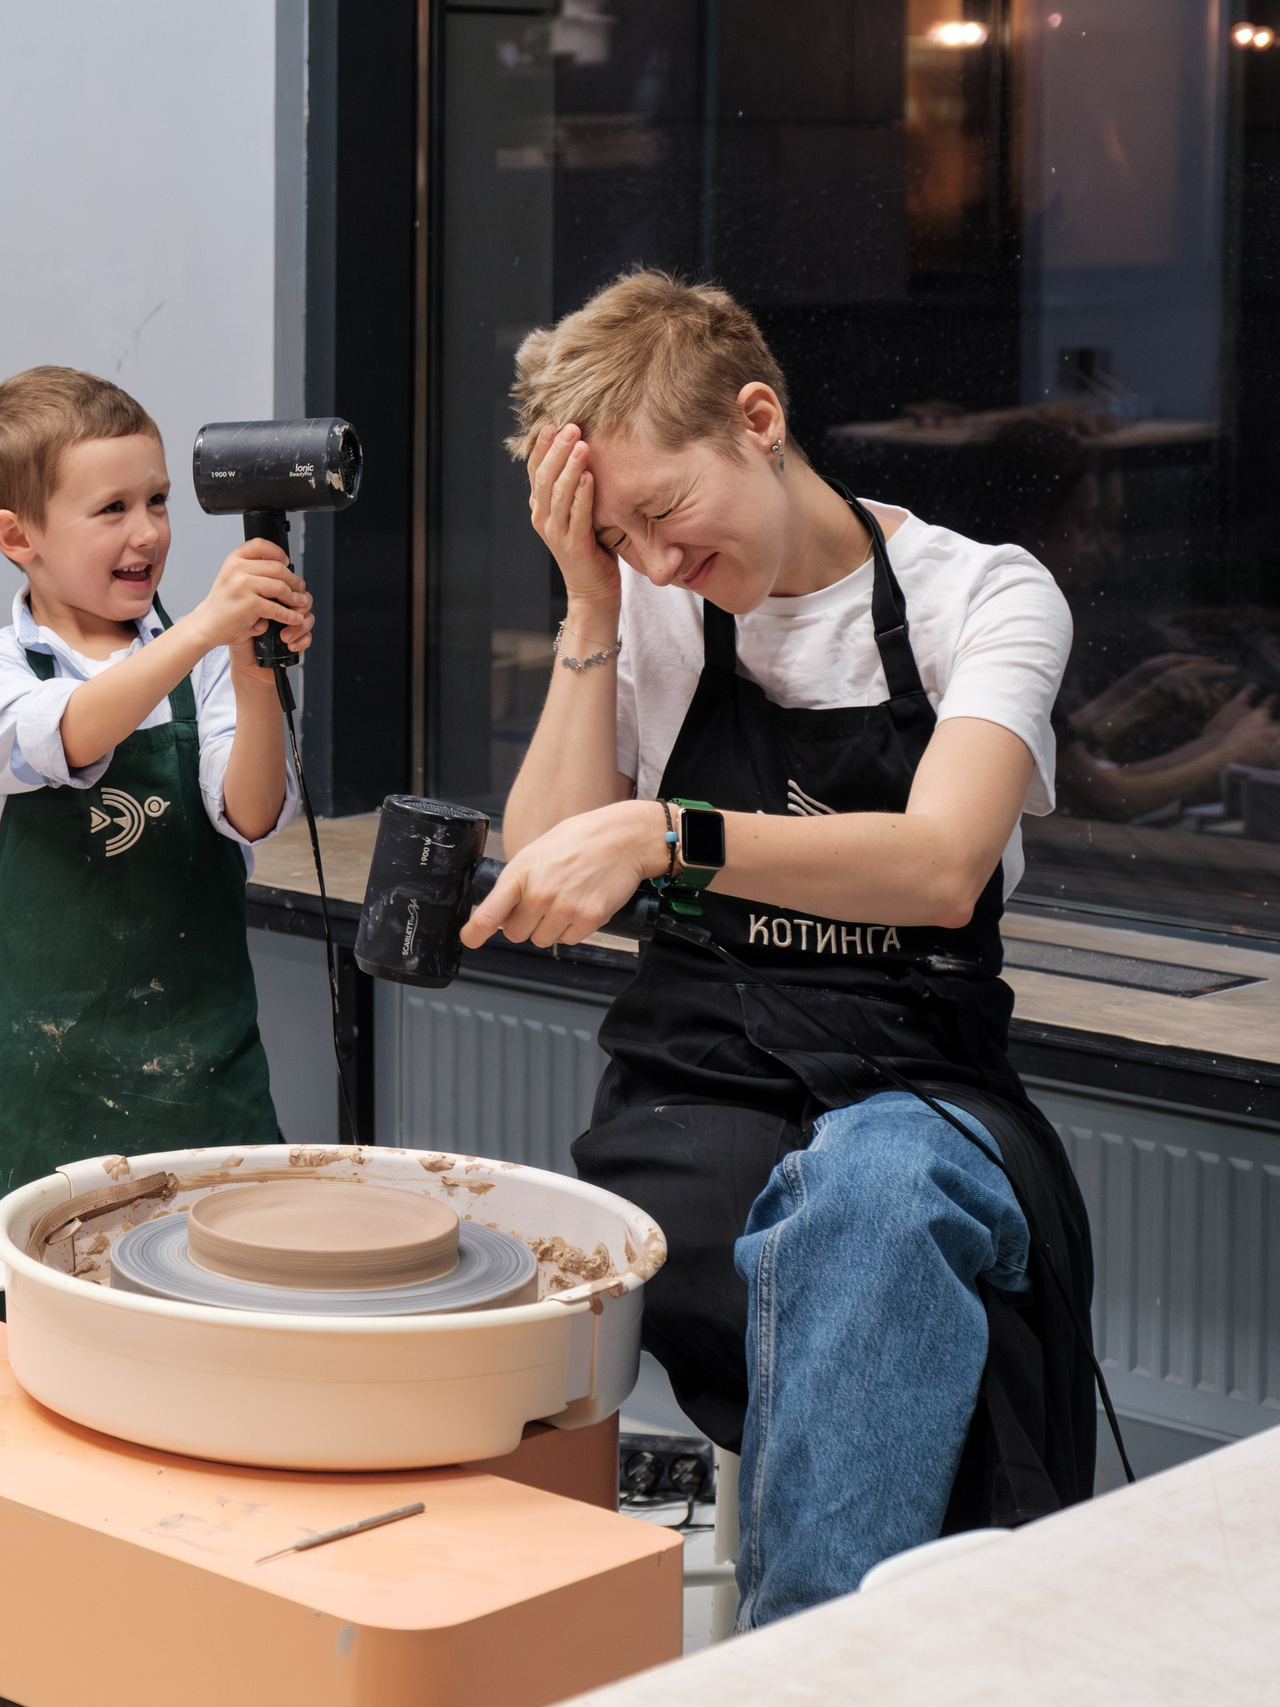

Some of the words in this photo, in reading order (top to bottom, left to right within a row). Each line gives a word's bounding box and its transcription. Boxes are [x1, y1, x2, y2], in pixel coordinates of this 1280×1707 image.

[295, 463, 314, 472] Ionic
[424, 836, 431, 845] W
[420, 846, 430, 865] 1900
[402, 919, 414, 956] SCARLETT
[748, 914, 901, 955] КОТИНГА
